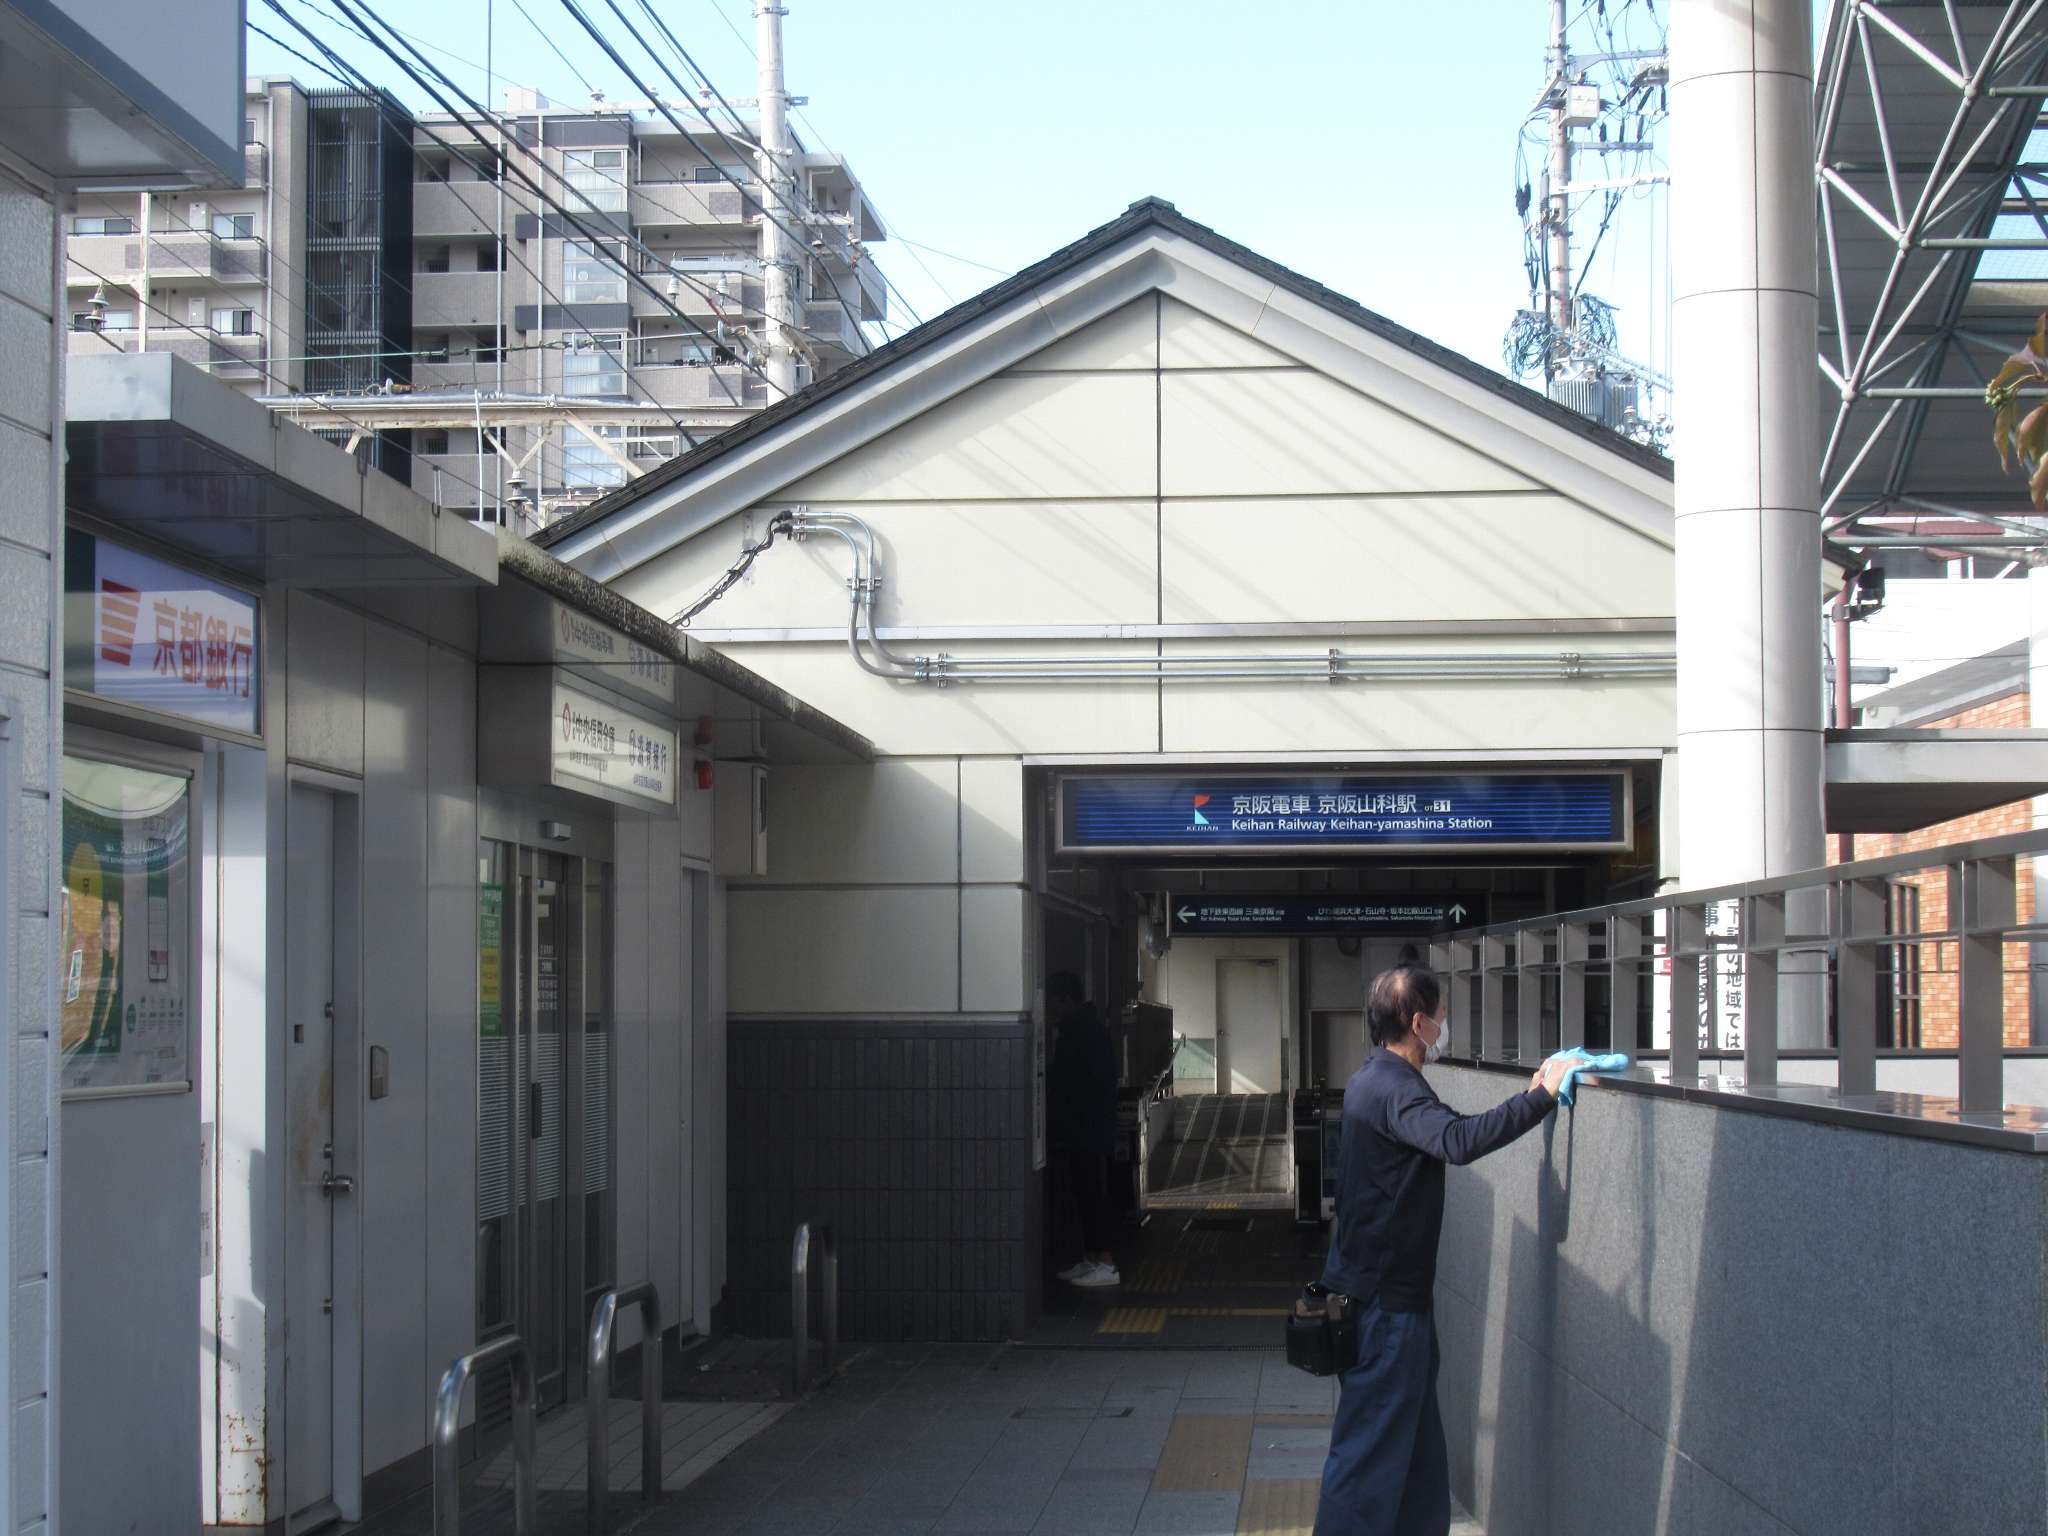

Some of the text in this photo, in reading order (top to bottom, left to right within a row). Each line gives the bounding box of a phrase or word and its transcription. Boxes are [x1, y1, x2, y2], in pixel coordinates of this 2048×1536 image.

[154, 598, 252, 698] 京都銀行
[1232, 795, 1311, 815] 京阪電車
[1317, 794, 1416, 814] 京阪山科駅
[1232, 817, 1493, 833] Keihan Railway Keihan-yamashina Station
